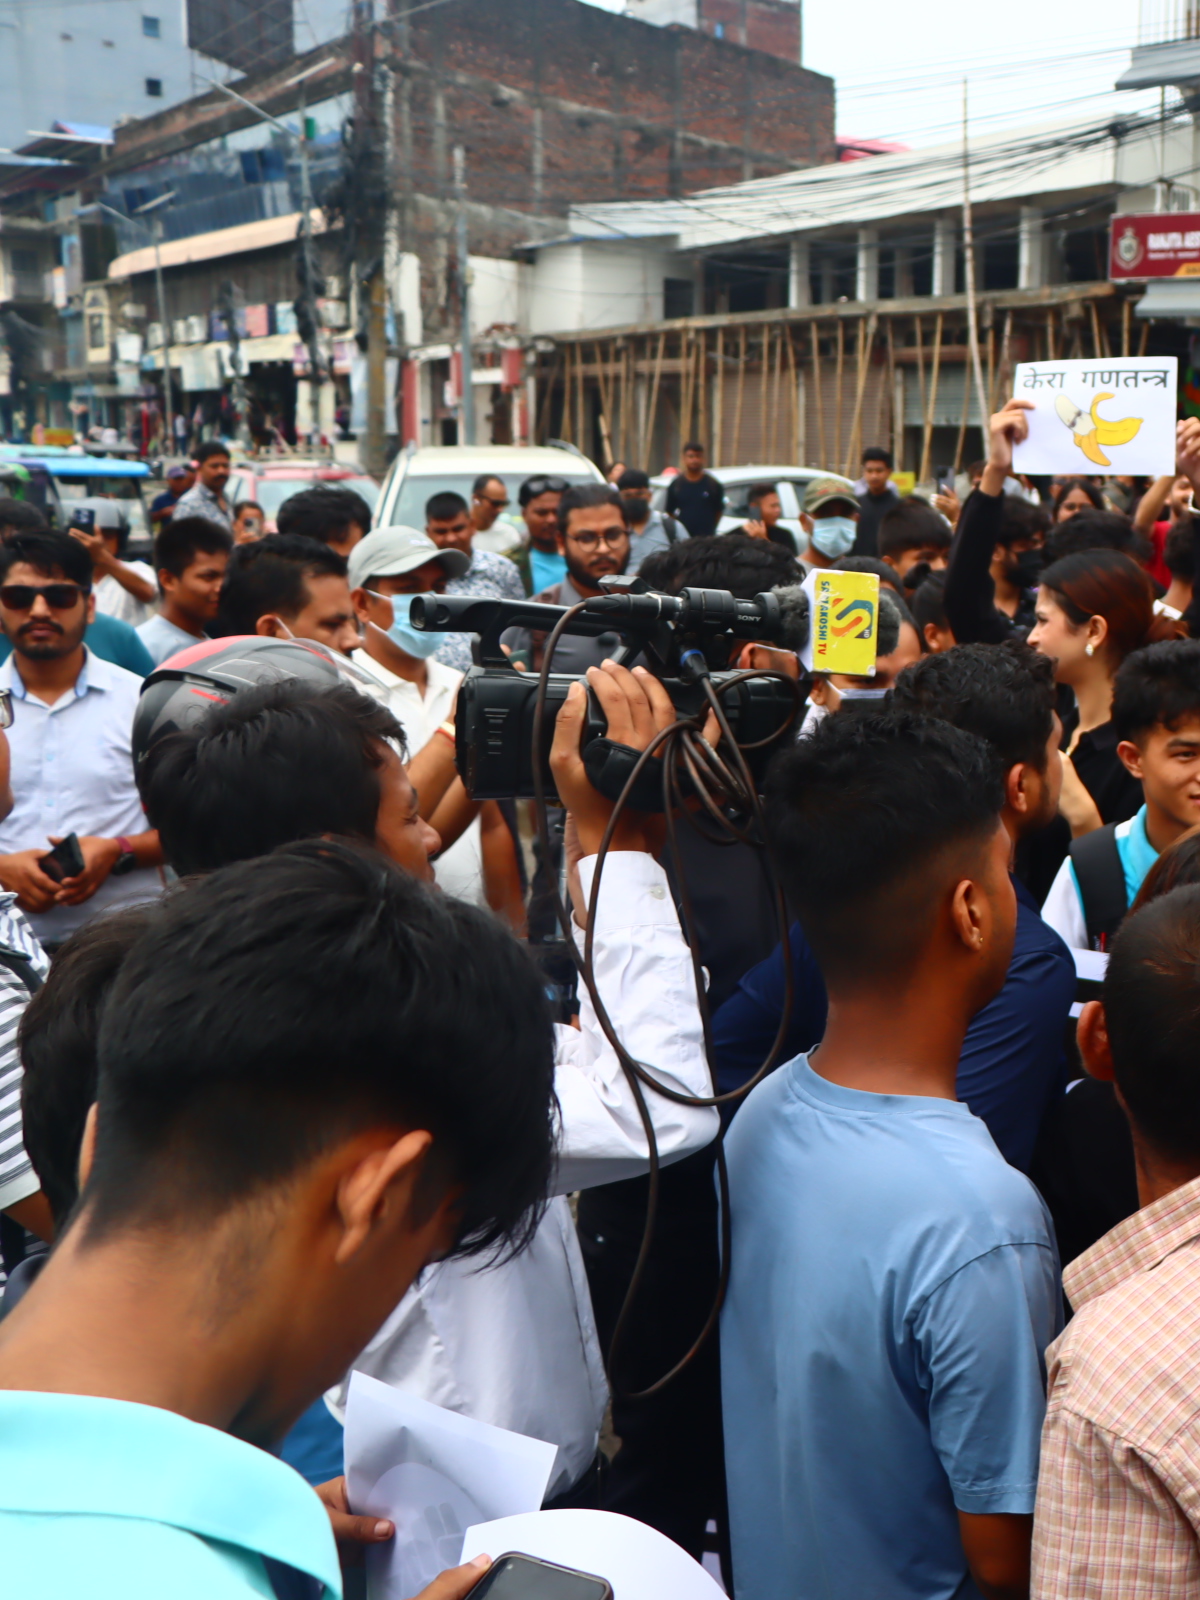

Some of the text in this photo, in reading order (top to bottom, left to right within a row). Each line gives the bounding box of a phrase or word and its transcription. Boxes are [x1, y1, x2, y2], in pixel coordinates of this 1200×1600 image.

[1023, 367, 1170, 389] केरा गणतन्त्र
[817, 581, 830, 655] SATAKOSHI TV
[863, 629, 870, 638] HD
